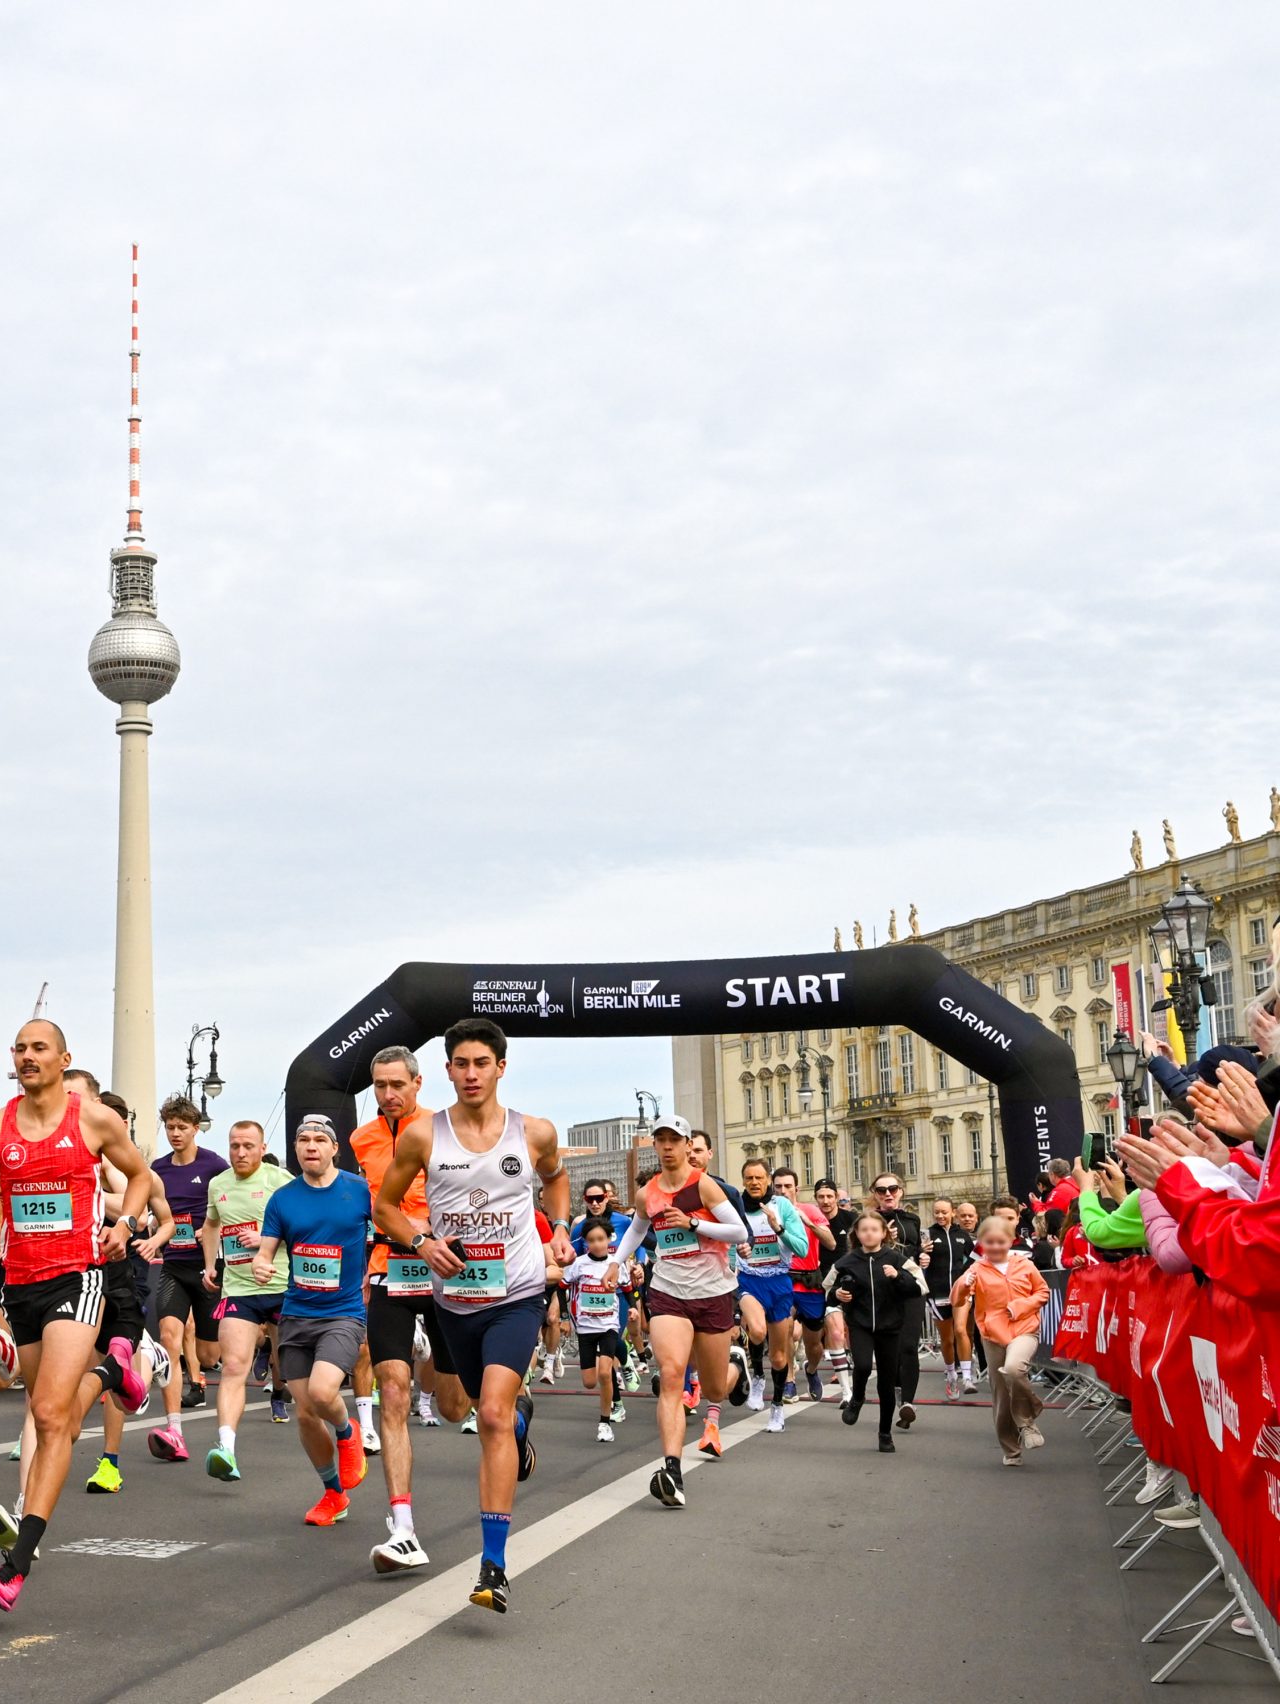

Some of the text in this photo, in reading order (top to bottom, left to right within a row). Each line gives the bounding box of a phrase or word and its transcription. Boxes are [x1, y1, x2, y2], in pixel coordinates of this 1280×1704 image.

[488, 981, 538, 991] GENERALI
[583, 986, 628, 995] GARMIN
[725, 973, 846, 1008] START
[473, 992, 526, 1002] BERLINER
[583, 994, 681, 1009] BERLIN MILE
[939, 997, 1013, 1052] GARMIN
[329, 1008, 393, 1059] GARMIN
[1034, 1105, 1052, 1173] EVENTS
[23, 1181, 67, 1192] GENERALI
[21, 1202, 57, 1216] 1215
[442, 1212, 514, 1227] PREVENT
[23, 1223, 55, 1231] GARMIN
[456, 1224, 517, 1240] SPRAIN
[664, 1232, 685, 1244] 670
[303, 1247, 339, 1256] GENERALI
[754, 1246, 770, 1255] 315
[302, 1262, 327, 1274] 806
[401, 1265, 429, 1277] 550
[302, 1278, 326, 1286] GARMIN
[589, 1296, 607, 1305] 334
